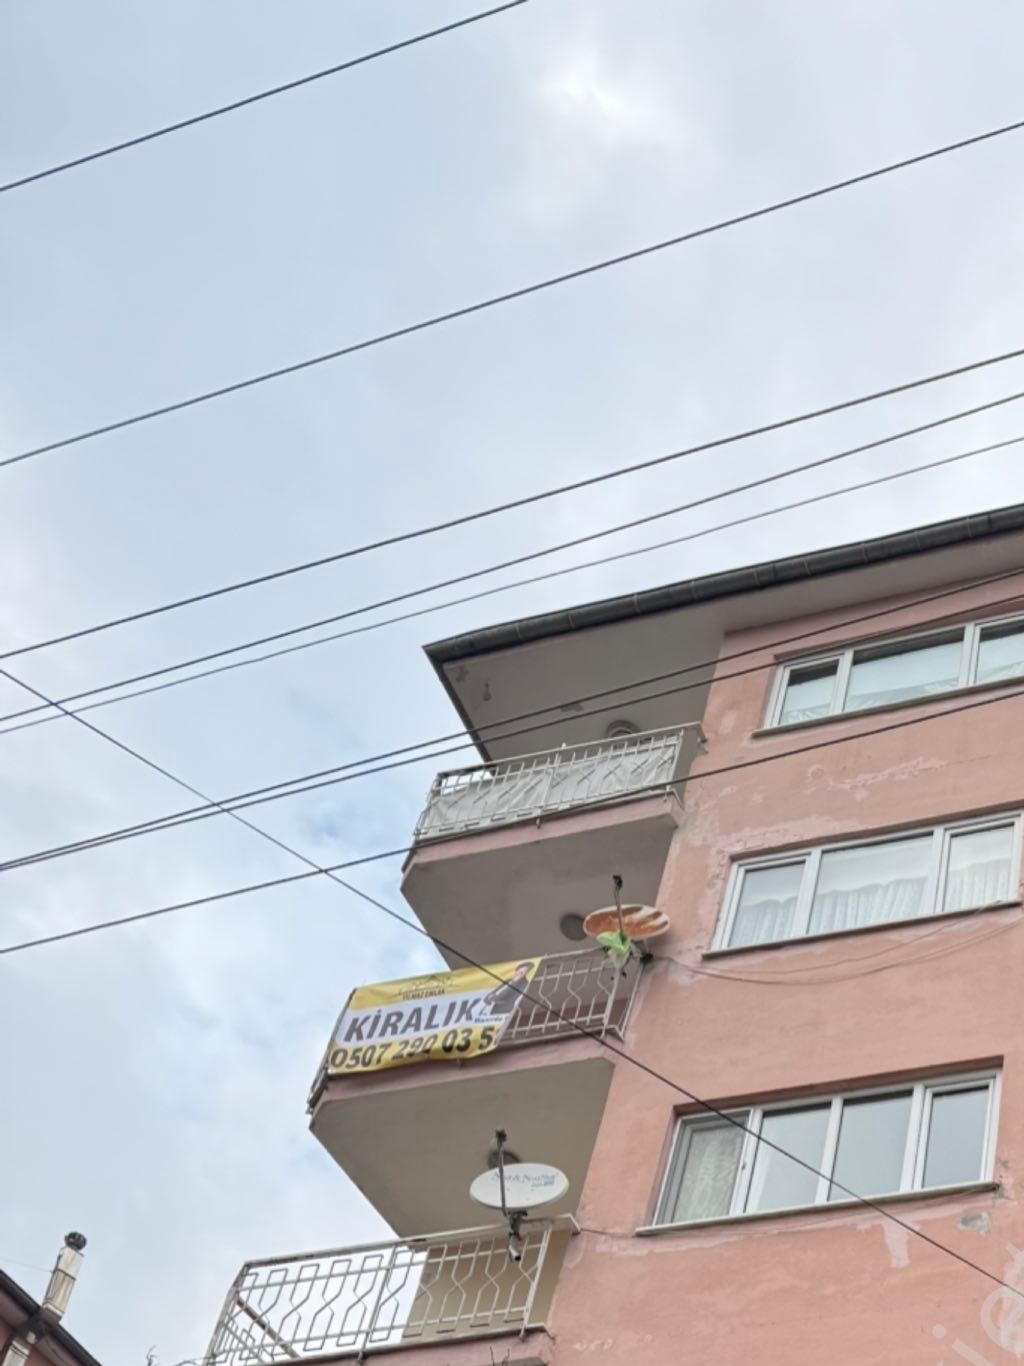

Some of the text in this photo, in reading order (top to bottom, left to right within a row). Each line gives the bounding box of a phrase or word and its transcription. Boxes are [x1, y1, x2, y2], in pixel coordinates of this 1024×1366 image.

[344, 998, 481, 1042] KİRALIK
[330, 1043, 391, 1068] 0507
[391, 1035, 438, 1060] 290
[441, 1028, 471, 1053] 03
